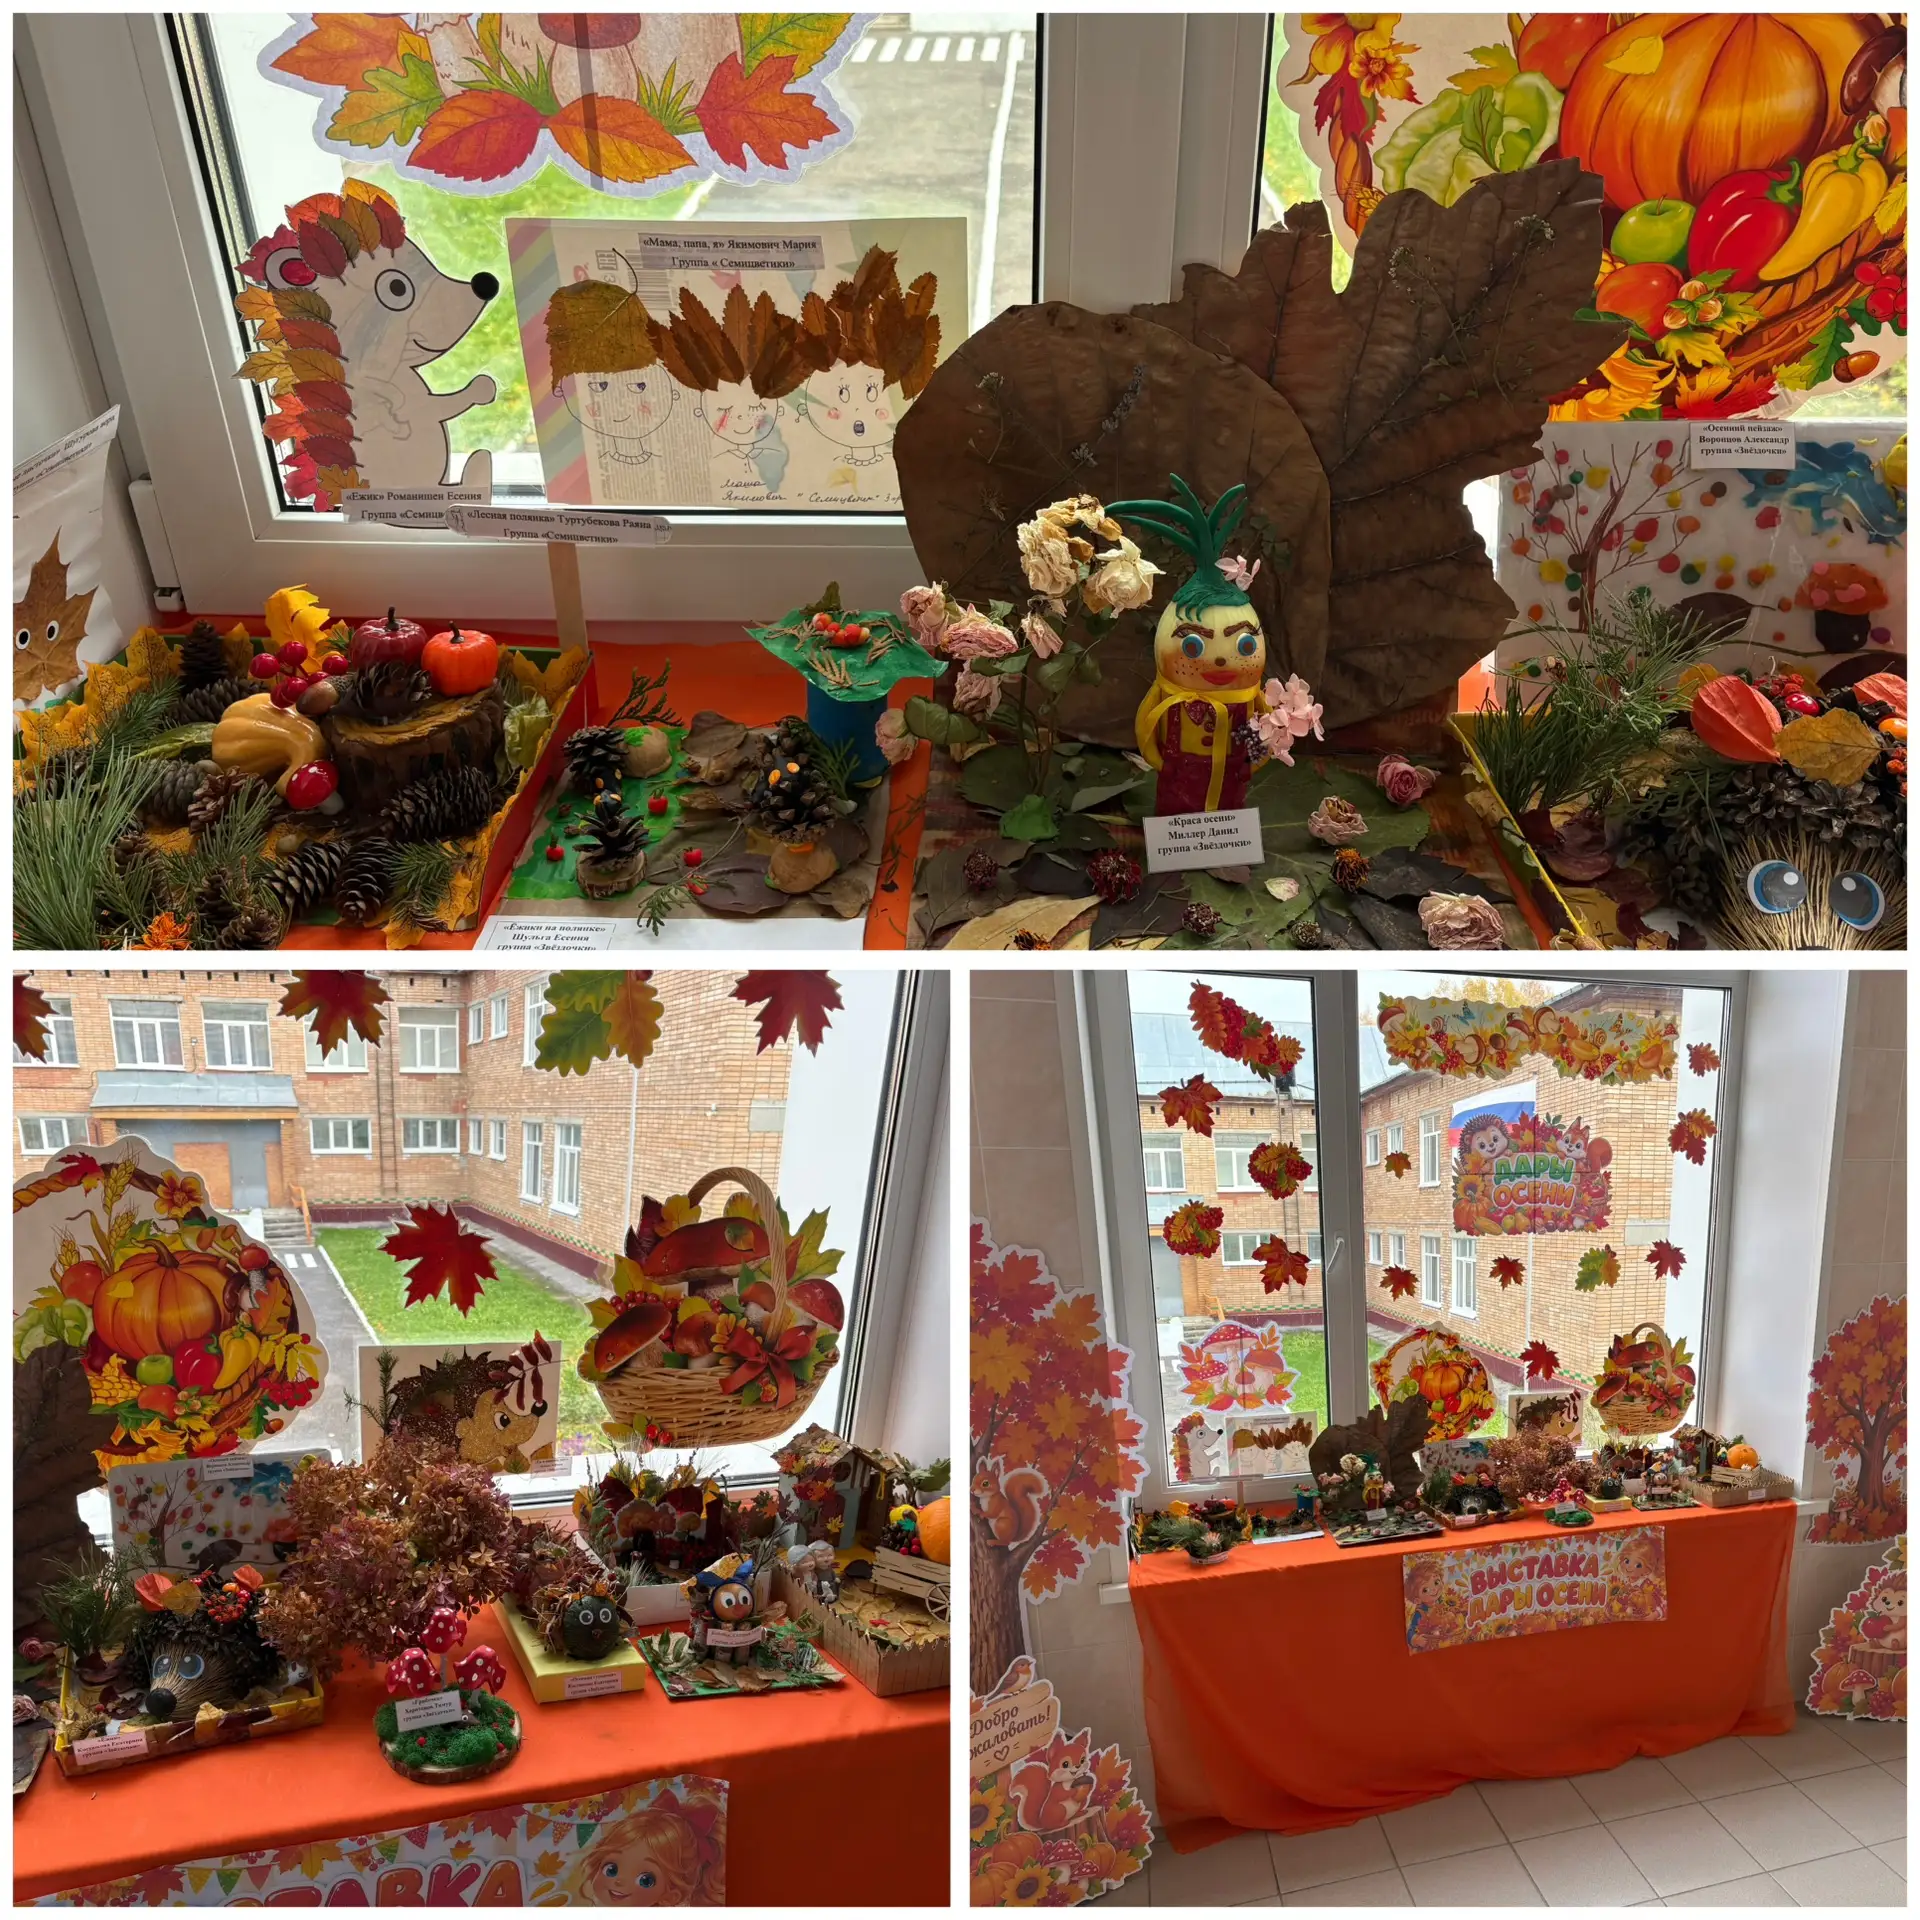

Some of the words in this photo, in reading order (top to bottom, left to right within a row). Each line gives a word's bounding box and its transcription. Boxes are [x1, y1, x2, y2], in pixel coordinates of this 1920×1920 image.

[643, 237, 680, 249] «Мама,
[684, 240, 710, 249] папа,
[712, 241, 724, 249] я»
[728, 240, 779, 250] Якимович
[782, 240, 817, 251] Мария
[672, 256, 709, 269] Группа
[1703, 424, 1745, 432] «Осенний
[1748, 424, 1782, 432] пейзаж»
[1699, 436, 1742, 444] Воронцов
[1744, 436, 1789, 445] Александр
[1701, 448, 1732, 456] группа
[1734, 446, 1786, 455] «Звёздочки»
[387, 491, 444, 501] Романишен
[447, 492, 482, 501] Есения
[361, 510, 397, 521] Группа
[467, 510, 507, 521] «Лесная
[510, 513, 555, 523] полянка»
[557, 514, 620, 527] Туртубекова
[503, 528, 539, 541] Группа
[542, 530, 618, 544] «Семицветики»
[1168, 817, 1202, 828] «Краса
[1204, 814, 1236, 824] осени»
[1168, 830, 1206, 840] Миллер
[1208, 827, 1239, 838] Данил
[1157, 845, 1191, 856] группа
[1193, 840, 1252, 851] «Звёздочки»
[560, 925, 606, 933] полянке»
[512, 933, 551, 942] Шульга
[554, 933, 589, 942] Есения
[1493, 1154, 1575, 1185] ДАРЫ
[1493, 1181, 1576, 1209] ОСЕНИ
[1470, 1552, 1599, 1595] ВЫСТАВКА
[1467, 1586, 1533, 1625] ДАРЫ
[1535, 1580, 1607, 1607] ОСЕНИ
[970, 1706, 1018, 1738] Добро
